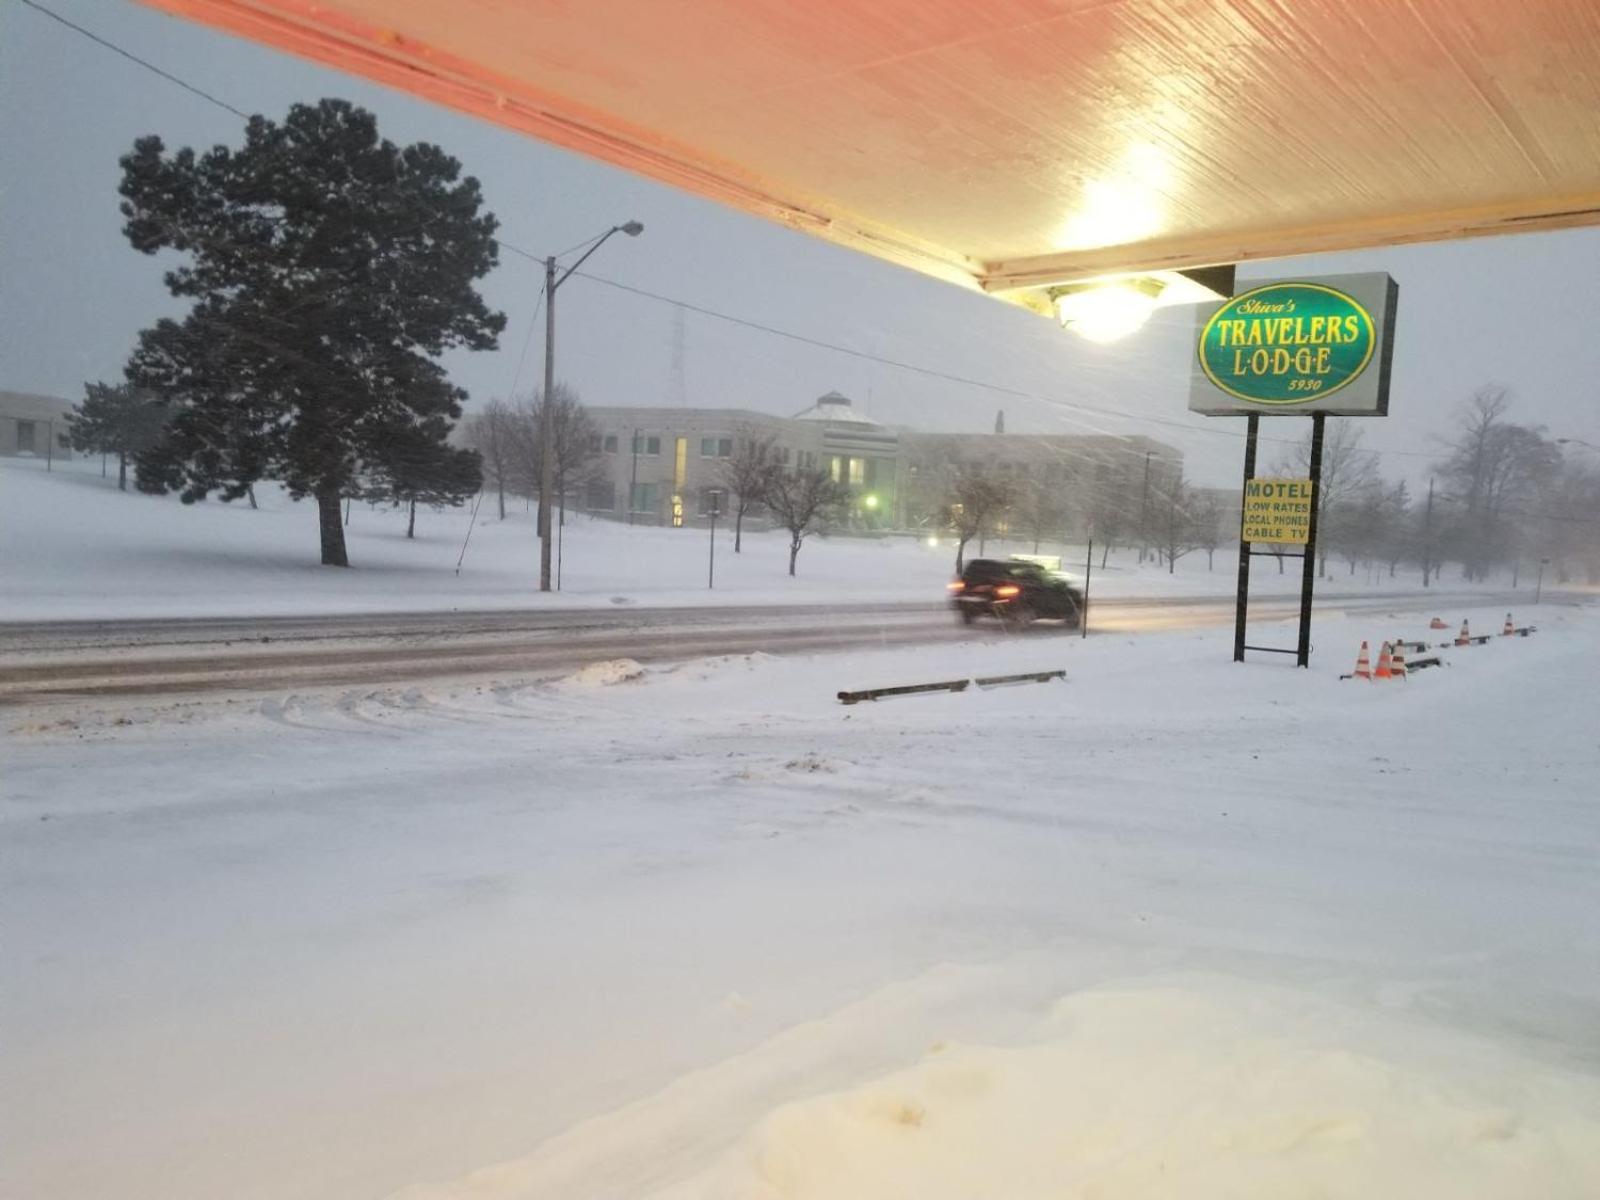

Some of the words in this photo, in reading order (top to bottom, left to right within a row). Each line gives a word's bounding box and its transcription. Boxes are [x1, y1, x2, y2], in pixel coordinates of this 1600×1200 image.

[1217, 315, 1360, 347] TRAVELERS
[1287, 380, 1322, 391] 5930
[1247, 483, 1310, 498] MOTEL
[1247, 502, 1271, 512] LOW
[1273, 502, 1309, 513] RATES
[1244, 514, 1271, 525] LOCAL
[1273, 516, 1309, 526] PHONES
[1245, 527, 1282, 538] CABLE
[1290, 529, 1306, 539] TV
